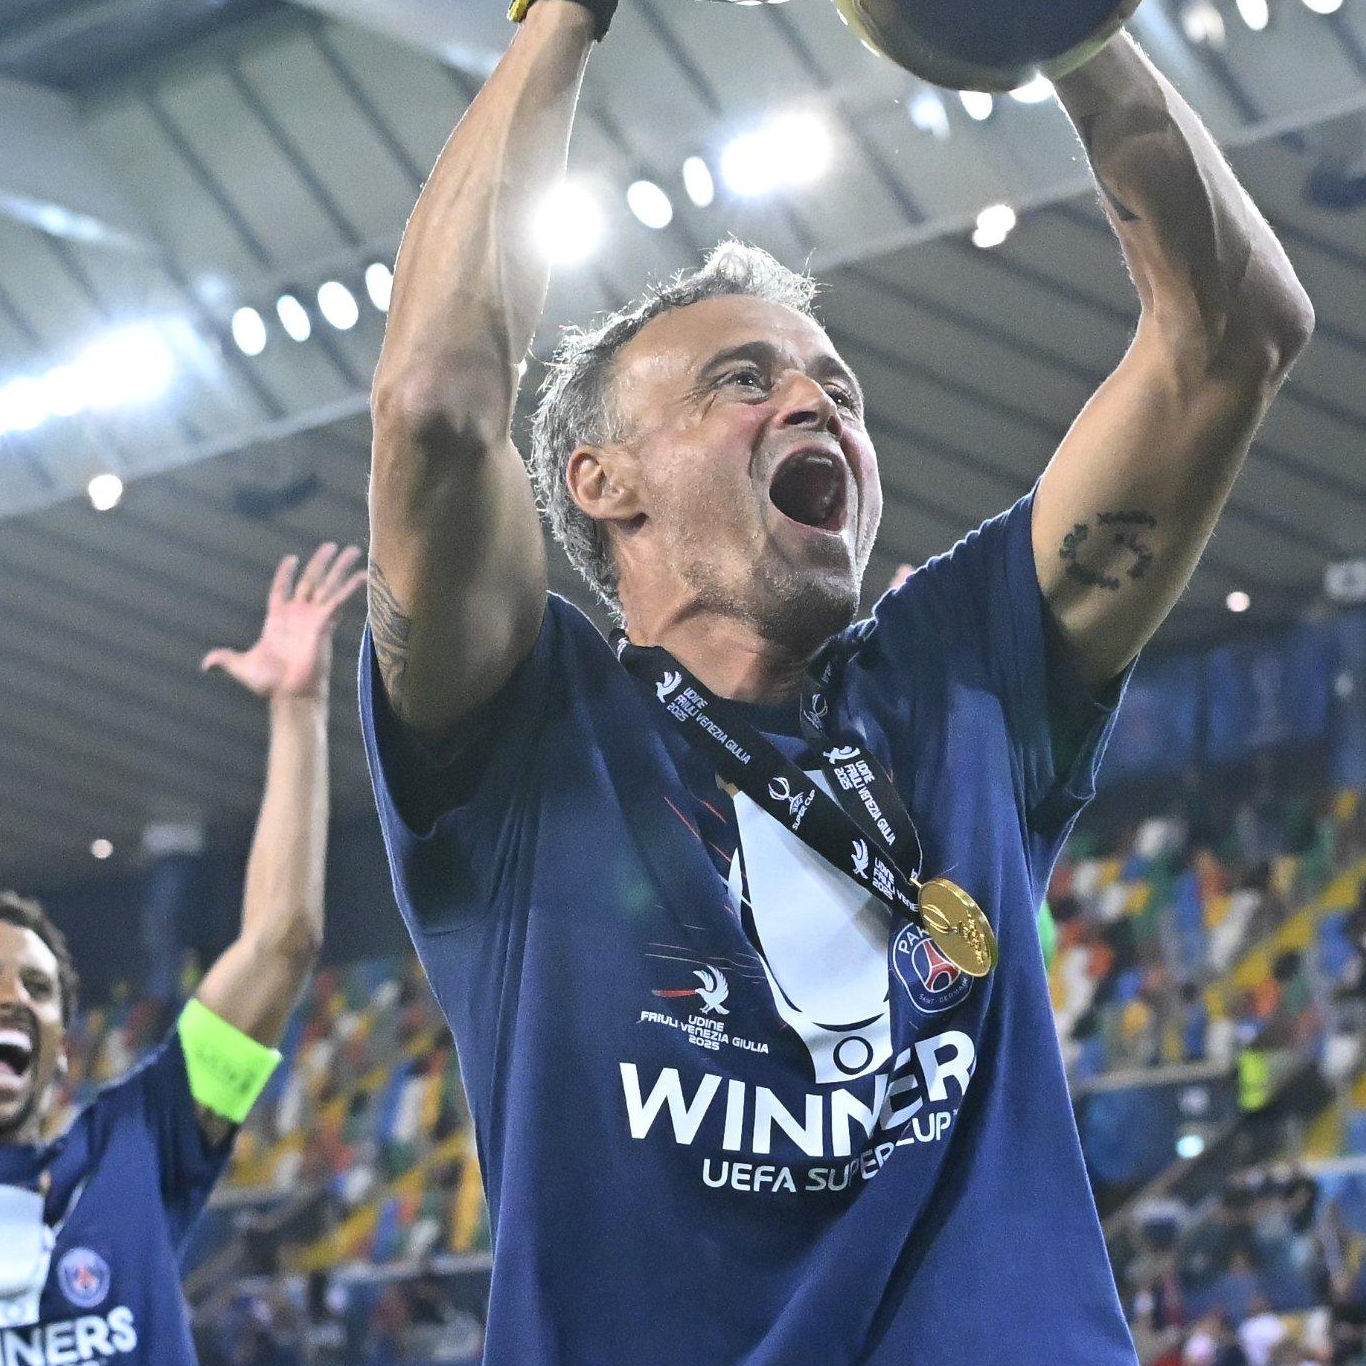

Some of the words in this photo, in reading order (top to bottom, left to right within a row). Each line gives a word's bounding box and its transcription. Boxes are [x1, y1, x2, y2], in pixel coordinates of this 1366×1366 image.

[683, 687, 708, 709] UDINE
[666, 702, 689, 722] 2025
[674, 695, 699, 717] FRIULI
[695, 713, 728, 743] VENEZIA
[725, 739, 751, 765] GIULIA
[834, 768, 852, 790] 2025
[856, 760, 875, 783] UDINE
[792, 805, 807, 830] SUPER
[805, 789, 815, 806] CUP
[844, 765, 864, 789] FRIULI
[858, 787, 882, 821] VENEZIA
[877, 817, 896, 846] GIULIA
[896, 889, 919, 912] VENE
[640, 1010, 678, 1029] FRIULI
[680, 1022, 729, 1044] VENEZIA
[732, 1036, 769, 1054] GIULIA
[688, 1014, 724, 1032] UDINE
[688, 1034, 720, 1051] 2025
[619, 1029, 977, 1158] WINNER
[702, 1158, 796, 1193] UEFA
[805, 1141, 895, 1192] SUPER
